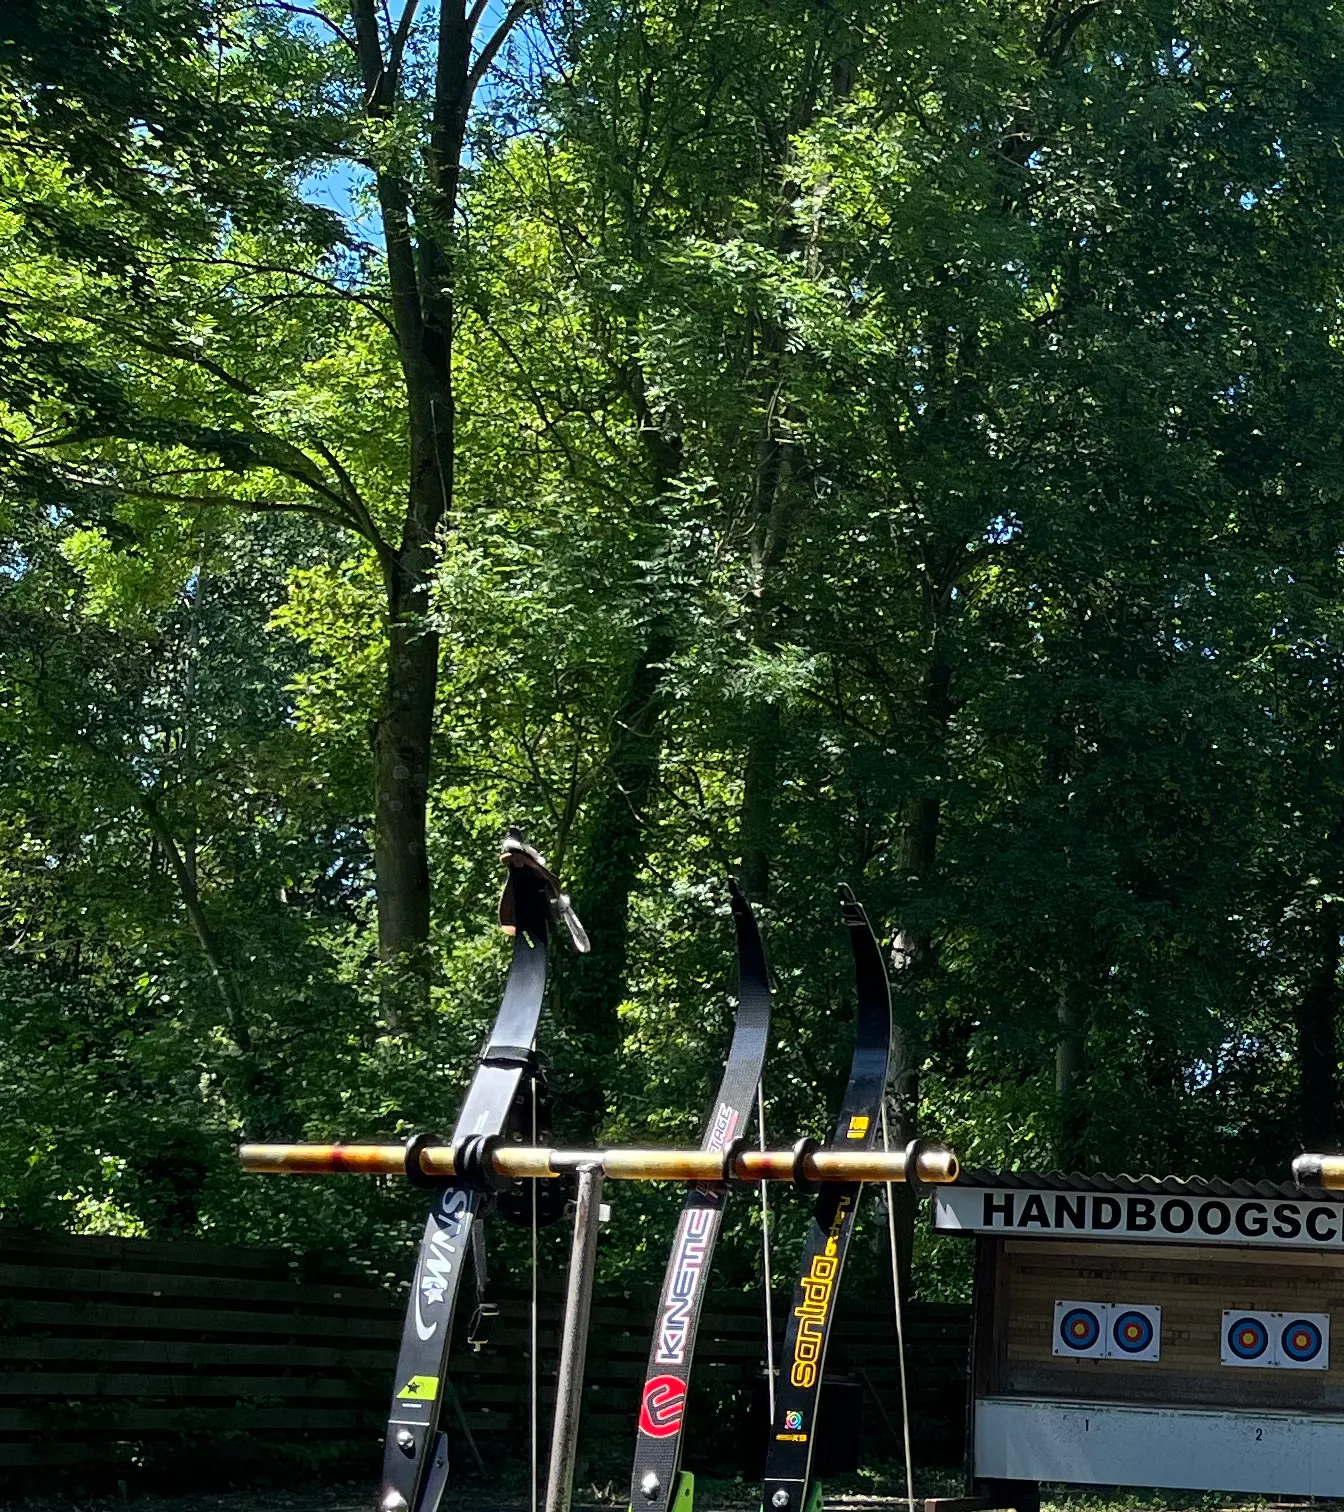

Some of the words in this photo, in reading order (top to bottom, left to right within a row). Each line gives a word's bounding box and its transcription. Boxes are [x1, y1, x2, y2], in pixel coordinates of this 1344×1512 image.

[657, 1209, 715, 1362] KINETIC
[1084, 1418, 1090, 1432] 1
[1255, 1428, 1263, 1441] 2
